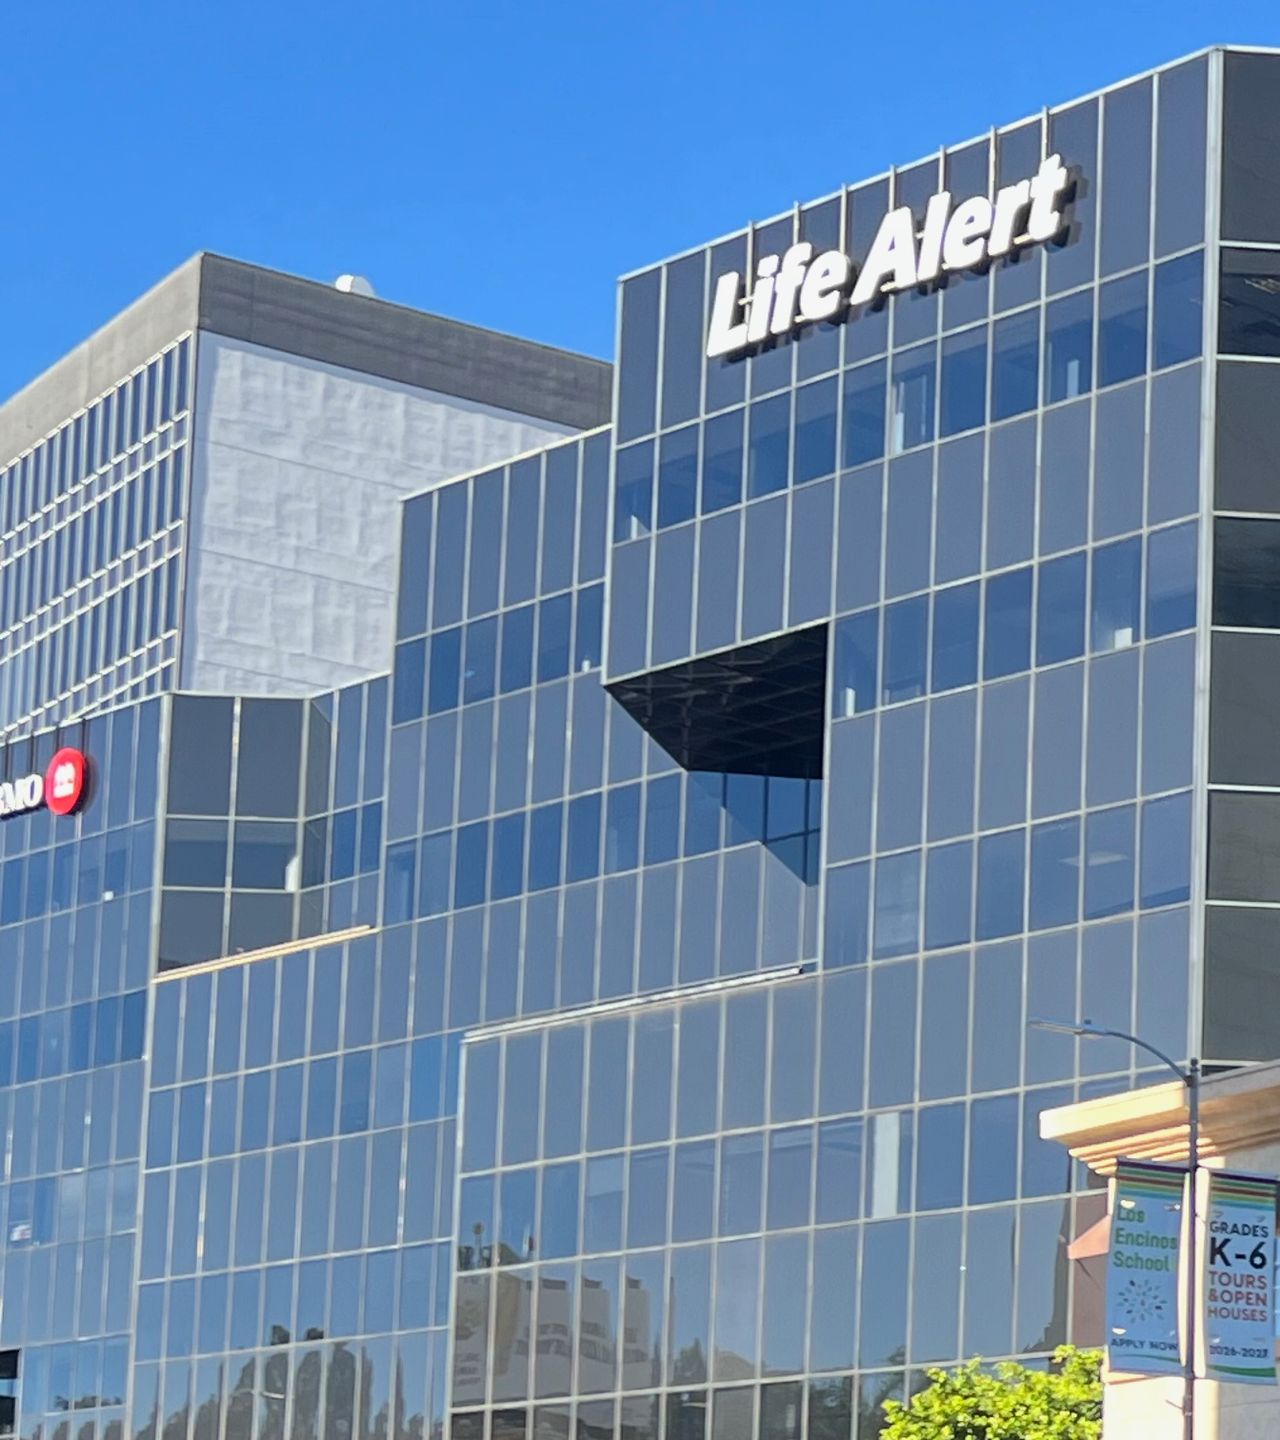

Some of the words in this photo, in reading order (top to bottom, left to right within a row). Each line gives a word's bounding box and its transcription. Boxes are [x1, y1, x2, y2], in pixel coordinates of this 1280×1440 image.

[706, 241, 852, 358] Life
[850, 152, 1068, 305] Alert
[1117, 1204, 1145, 1223] Los
[1116, 1228, 1177, 1249] Encinos
[1210, 1221, 1269, 1238] GRADES
[1113, 1251, 1169, 1271] School
[1210, 1237, 1267, 1269] K-6
[1209, 1271, 1267, 1290] TOURS
[1208, 1306, 1267, 1322] HOUSES
[1111, 1338, 1144, 1349] APPLY
